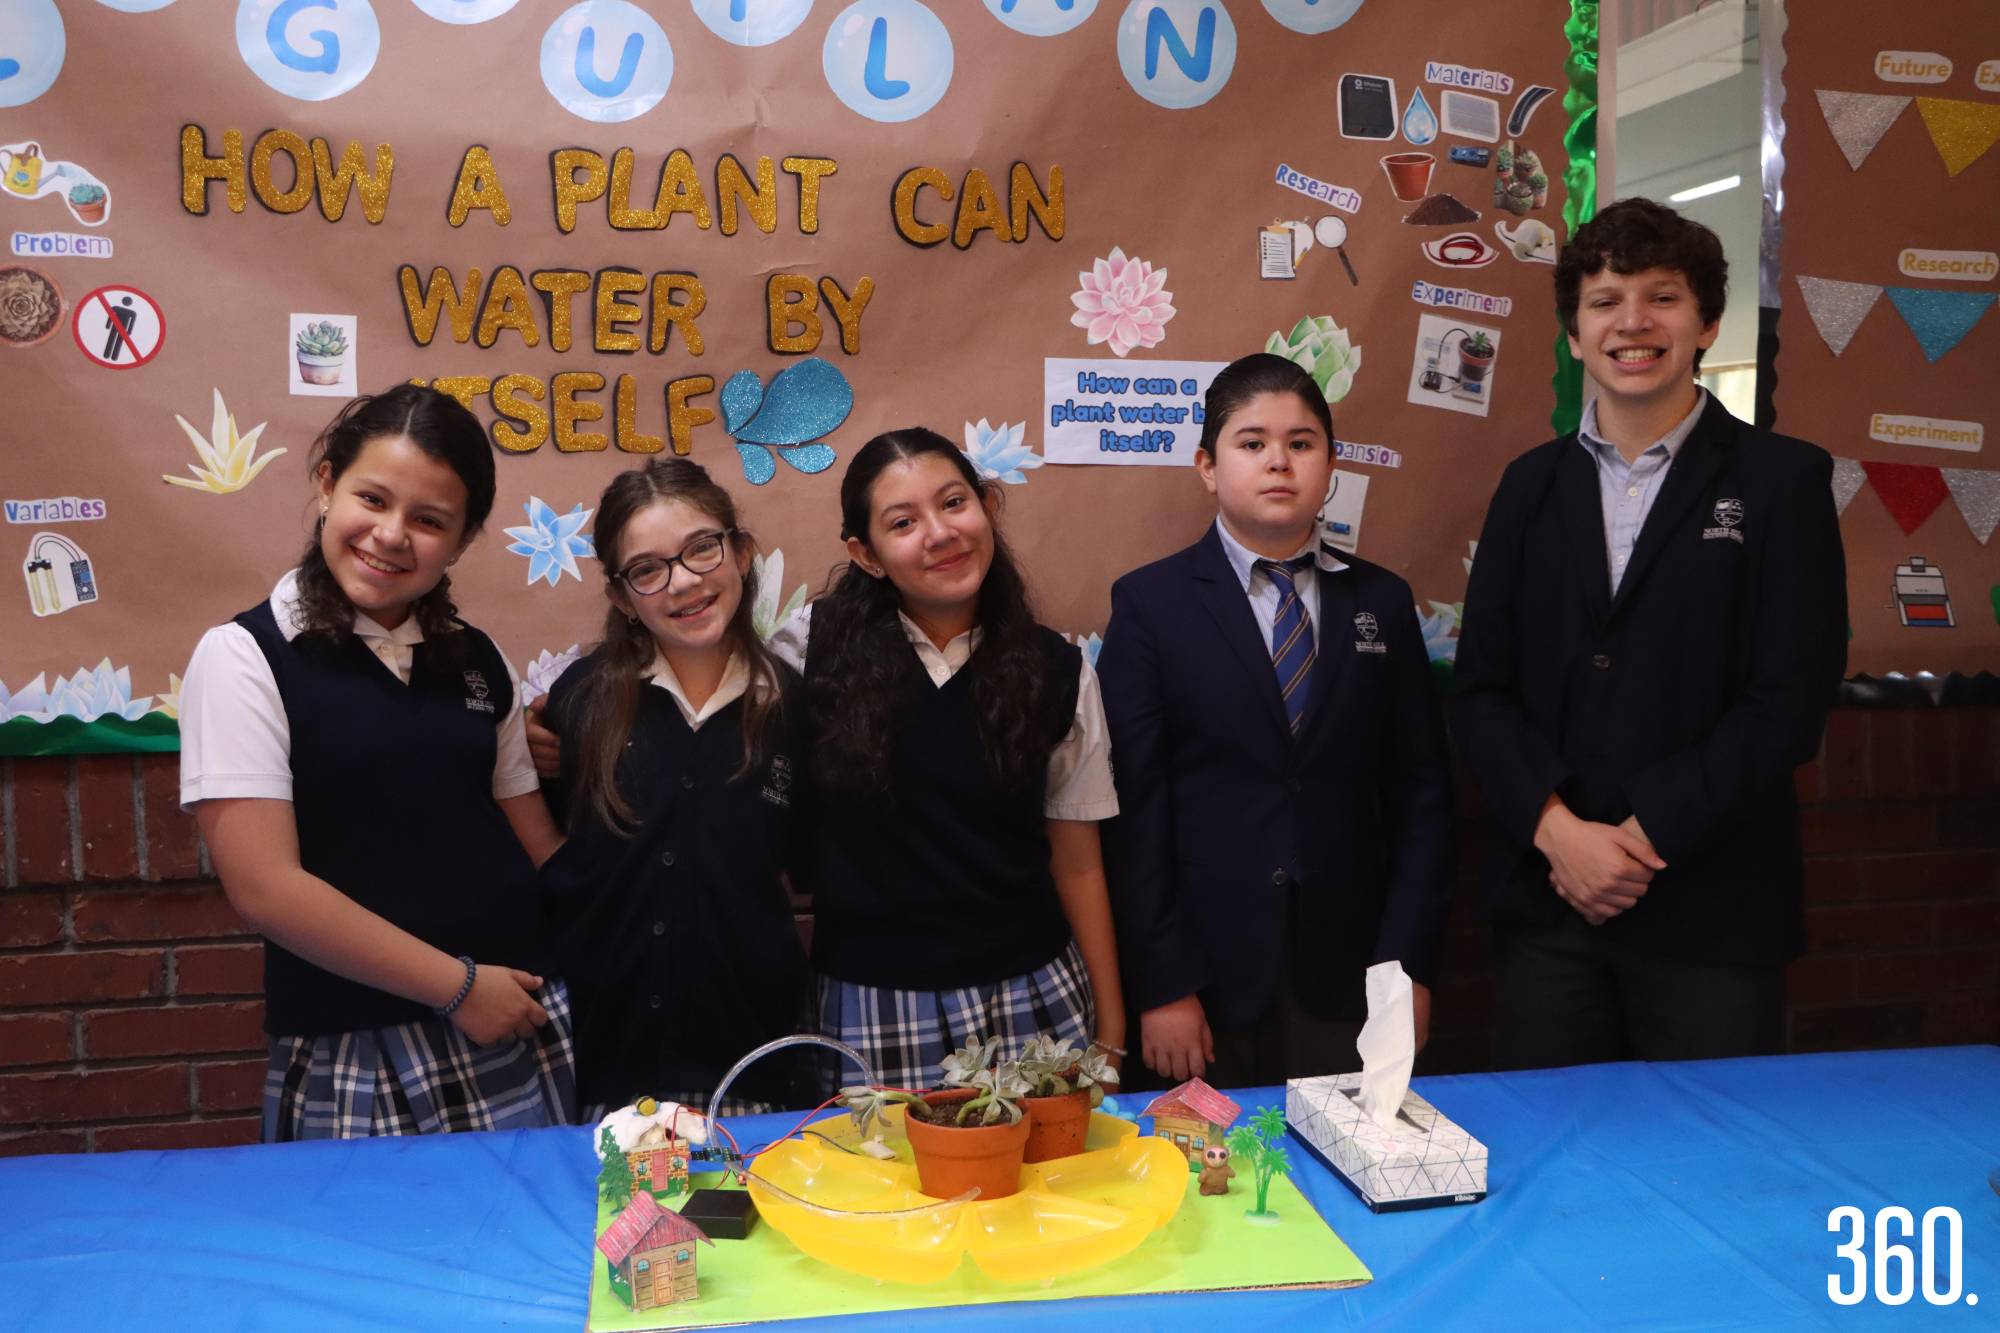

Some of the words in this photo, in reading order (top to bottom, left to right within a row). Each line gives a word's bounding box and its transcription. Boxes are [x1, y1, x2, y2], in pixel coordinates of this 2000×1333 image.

[1427, 63, 1510, 92] Materials
[1879, 55, 1949, 77] Future
[180, 124, 394, 224] HOW
[447, 145, 512, 227] A
[549, 146, 838, 236] PLANT
[890, 161, 1065, 250] CAN
[1276, 164, 1360, 211] Research
[15, 233, 111, 255] Problem
[1903, 252, 1996, 274] Research
[398, 264, 707, 356] WATER
[765, 273, 875, 355] BY
[1413, 281, 1508, 315] Experiment
[1078, 371, 1130, 394] How
[1133, 377, 1177, 395] can
[1181, 378, 1197, 395] a
[408, 371, 715, 456] TSELF
[1051, 399, 1115, 427] plant
[1118, 402, 1189, 424] water
[1193, 401, 1206, 424] b
[1100, 429, 1175, 452] itself?
[1873, 415, 1980, 444] Experiment
[1335, 441, 1401, 467] pansion
[5, 498, 104, 521] Variables
